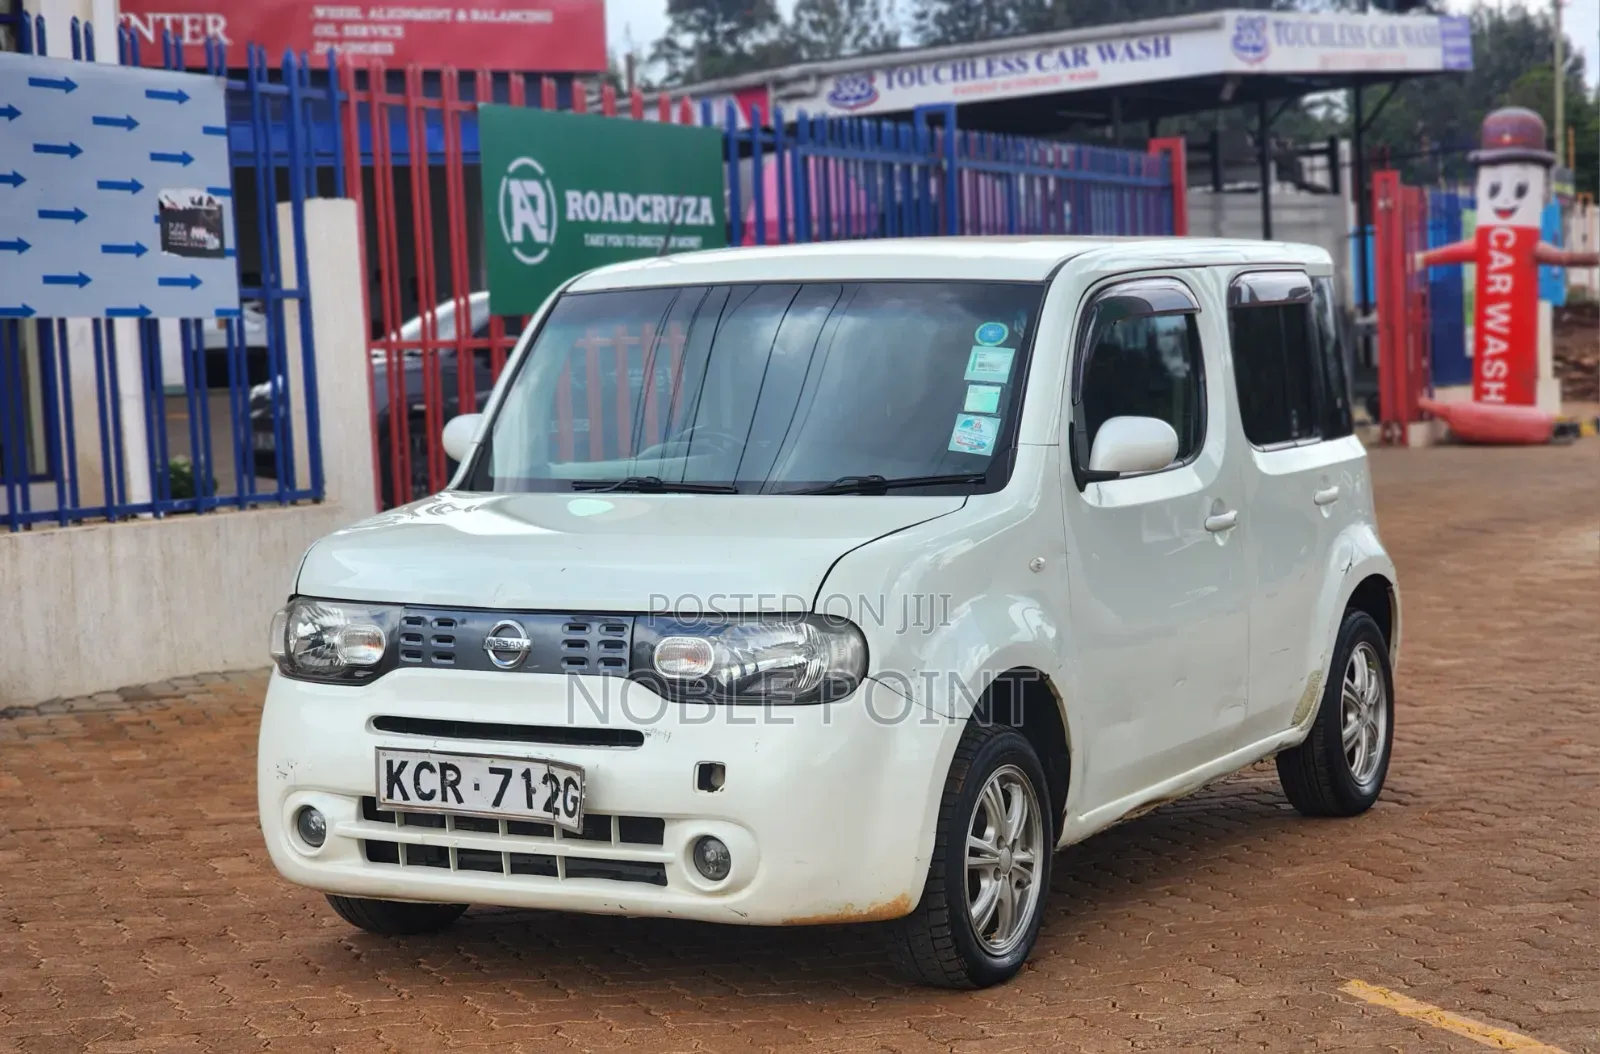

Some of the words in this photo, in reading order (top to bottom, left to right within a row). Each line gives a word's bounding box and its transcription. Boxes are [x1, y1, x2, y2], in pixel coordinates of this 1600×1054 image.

[883, 53, 1030, 91] TOUCHLESS
[1035, 46, 1090, 73] CAR
[1097, 35, 1172, 63] WASH
[565, 189, 716, 226] ROADCRUZA
[1486, 226, 1517, 295] CAR
[1482, 303, 1512, 404] WASH
[486, 639, 525, 649] NISSAN
